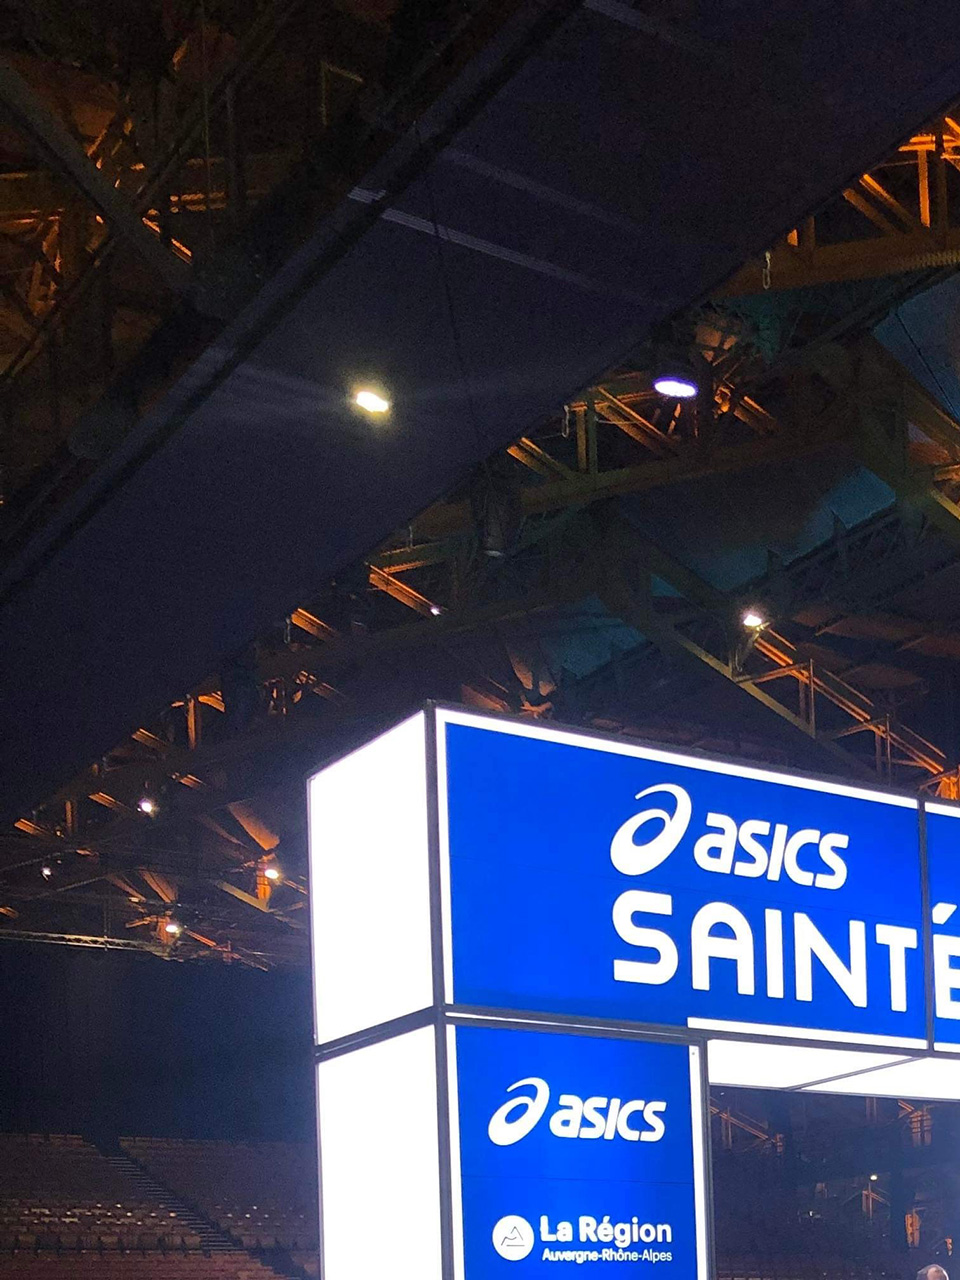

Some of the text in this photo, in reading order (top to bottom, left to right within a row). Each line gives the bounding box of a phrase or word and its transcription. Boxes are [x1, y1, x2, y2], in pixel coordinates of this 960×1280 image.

[693, 811, 849, 890] asics
[550, 1095, 666, 1141] asics
[540, 1215, 672, 1248] La Région
[542, 1249, 673, 1264] Auvergne-Rhône-Alpes
